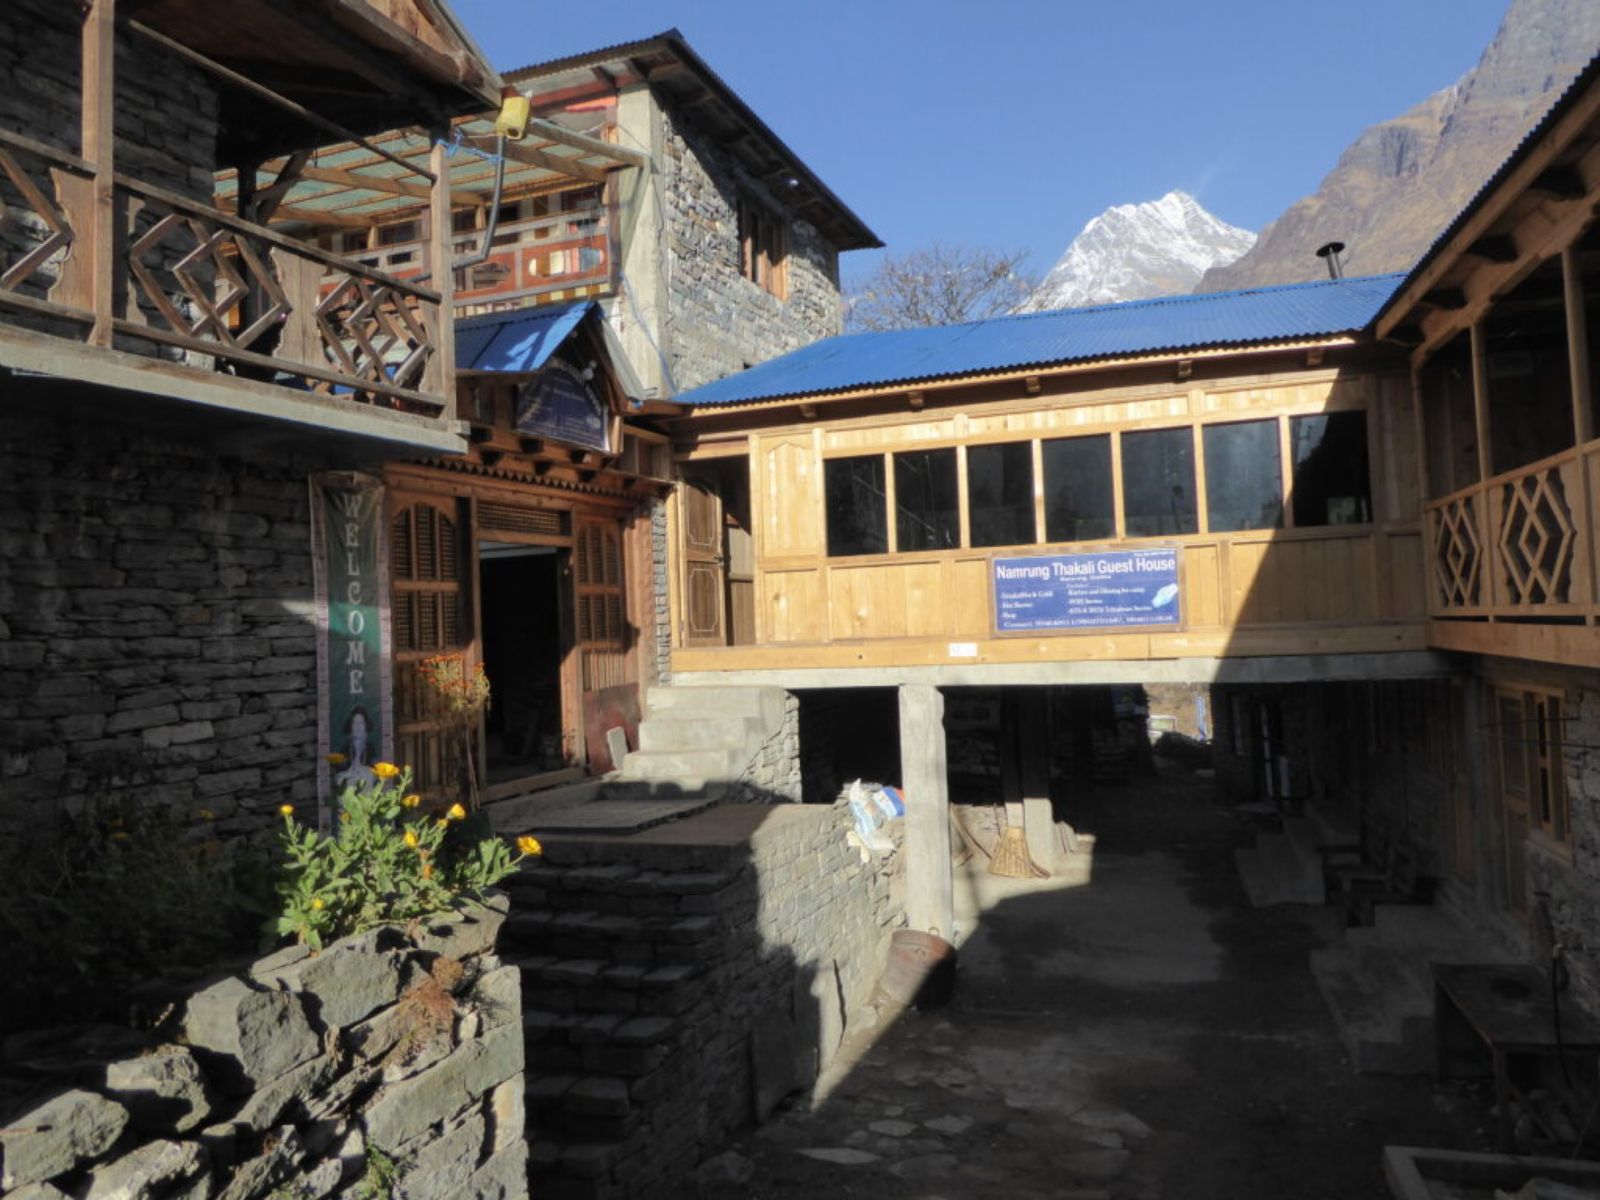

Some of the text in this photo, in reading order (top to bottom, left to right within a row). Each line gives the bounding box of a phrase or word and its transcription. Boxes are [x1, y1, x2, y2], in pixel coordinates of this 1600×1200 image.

[343, 493, 365, 695] WELCOME
[996, 565, 1050, 581] Namrung
[1052, 561, 1095, 576] Thakali
[1097, 558, 1133, 575] Guest
[1136, 556, 1176, 573] House
